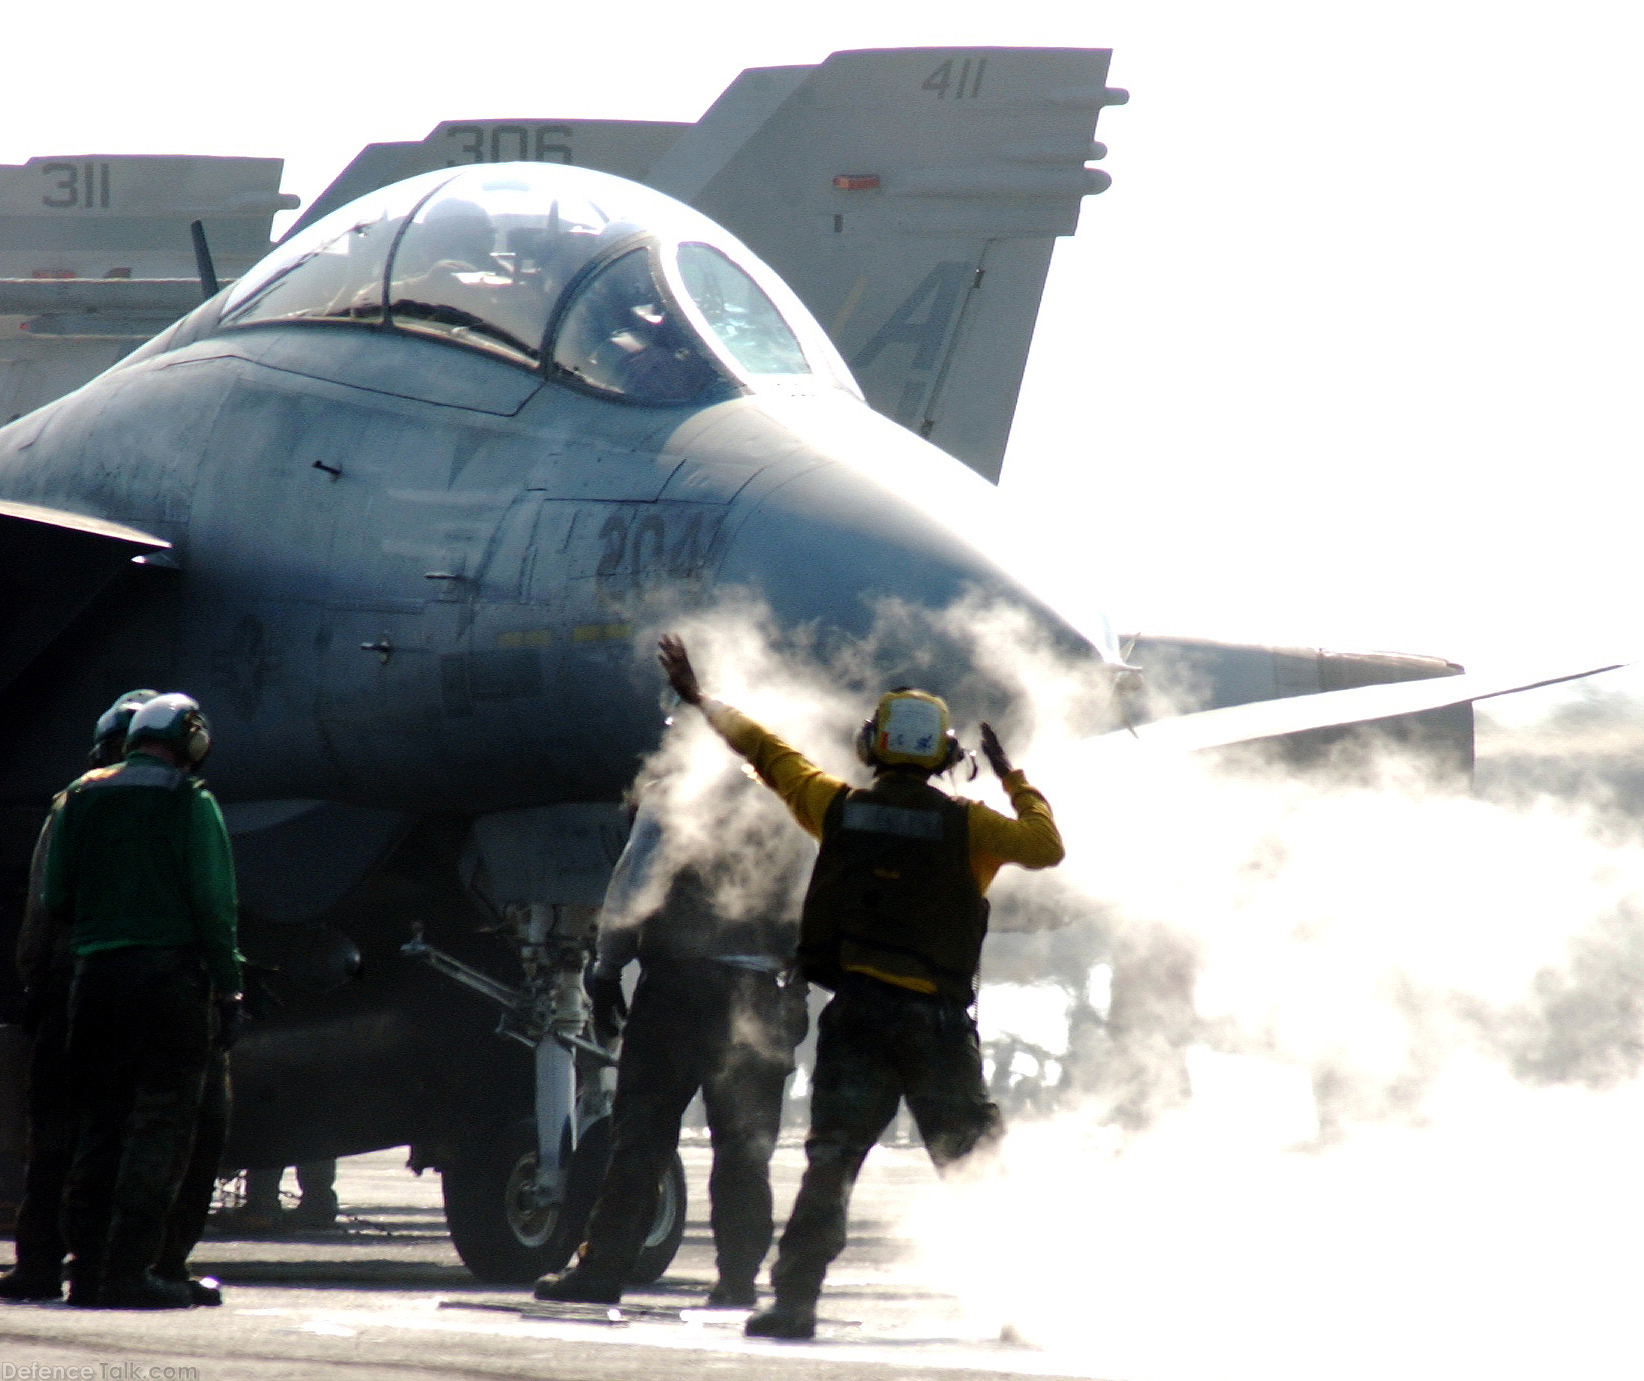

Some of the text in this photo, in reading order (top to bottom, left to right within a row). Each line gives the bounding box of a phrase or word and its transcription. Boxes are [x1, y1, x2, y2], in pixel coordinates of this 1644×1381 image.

[921, 57, 988, 100] 411
[446, 125, 573, 166] 306
[42, 162, 109, 208] 311
[850, 261, 971, 371] A
